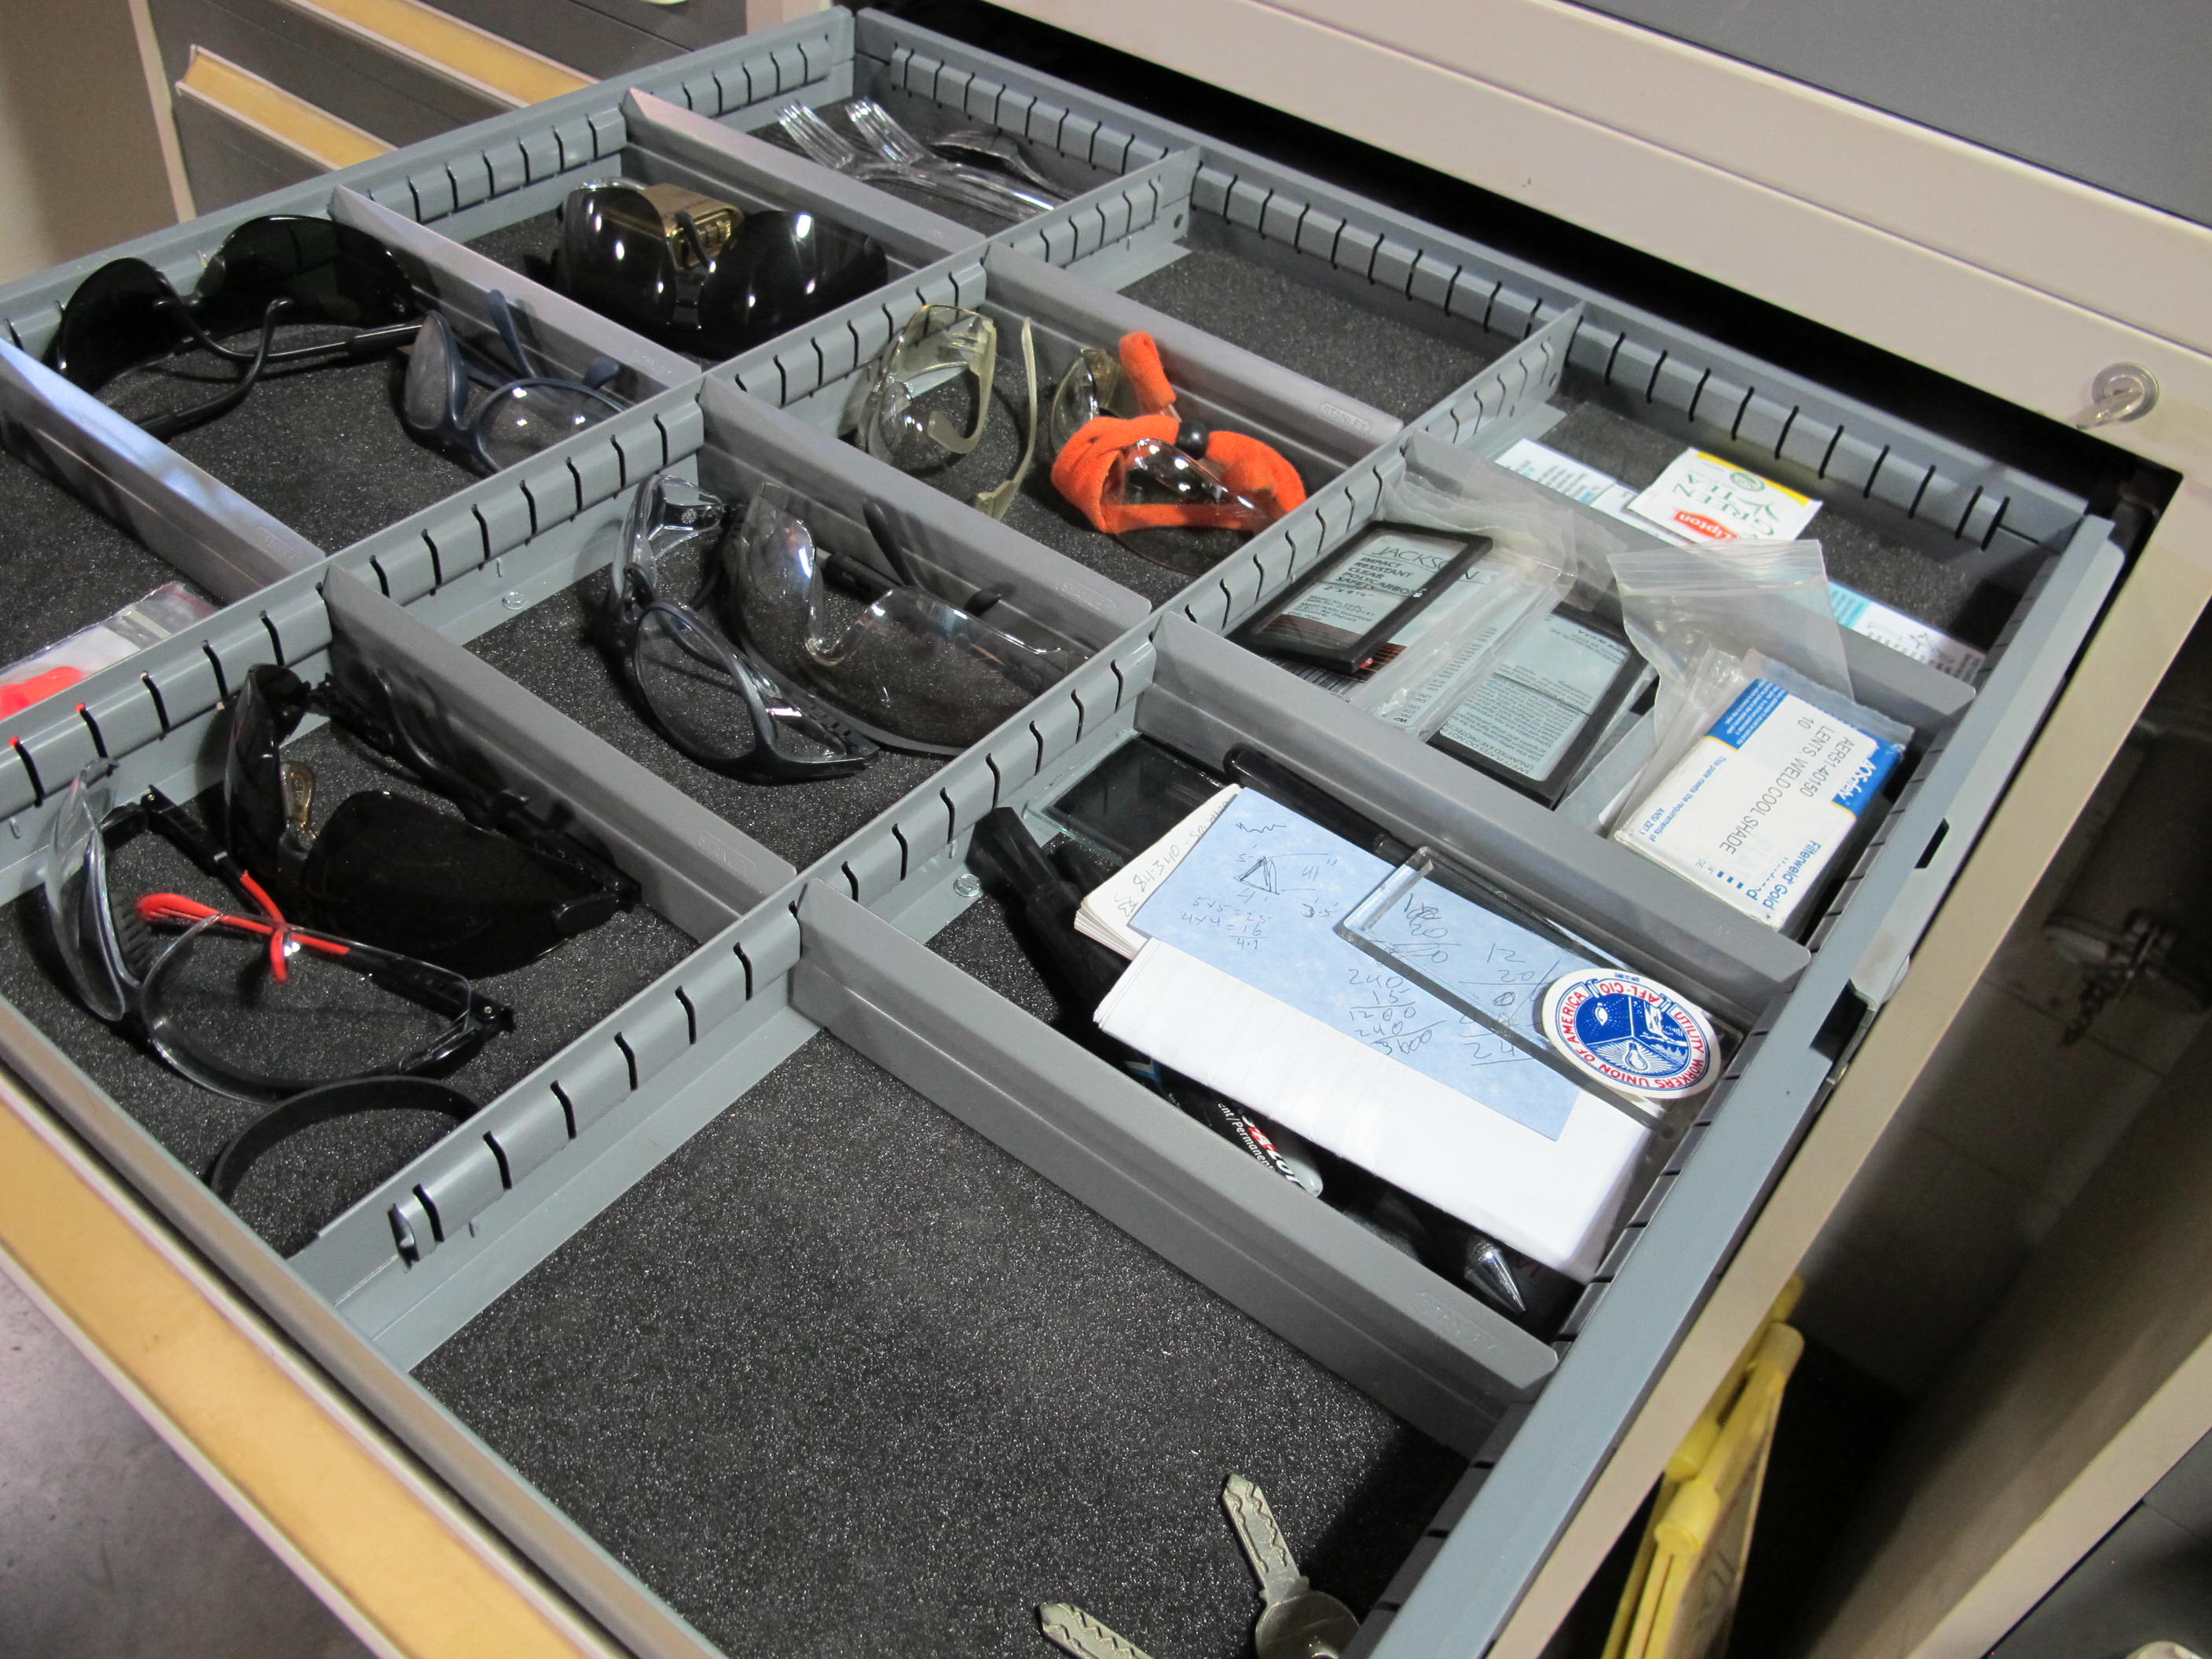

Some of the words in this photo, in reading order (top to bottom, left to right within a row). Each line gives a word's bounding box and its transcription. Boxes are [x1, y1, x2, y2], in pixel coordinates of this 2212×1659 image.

[1672, 483, 1774, 536] GREEN
[1678, 512, 1735, 540] Lipton
[1348, 566, 1386, 580] CLEAR
[1353, 562, 1415, 579] RESISTANT
[1360, 556, 1404, 568] IMPACT
[1797, 716, 1816, 731] 10
[1778, 758, 1810, 795] WELD
[1800, 737, 1855, 799] AER51-40150
[1751, 788, 1783, 817] COOL
[1650, 807, 1665, 822] ANSI
[1719, 815, 1760, 855] SHADE
[1763, 884, 1788, 910] Gold
[1485, 942, 1527, 964] 12
[1347, 968, 1404, 989] 240
[1497, 969, 1536, 983] 20
[1599, 981, 1661, 1003] AFL-CIO
[1561, 991, 1587, 1045] AMERICA
[1674, 1011, 1705, 1054] UTILITY
[1461, 1039, 1516, 1060] 24
[1576, 1049, 1597, 1064] OF
[1599, 1064, 1650, 1088] UNION
[1656, 1057, 1705, 1090] WORKERS
